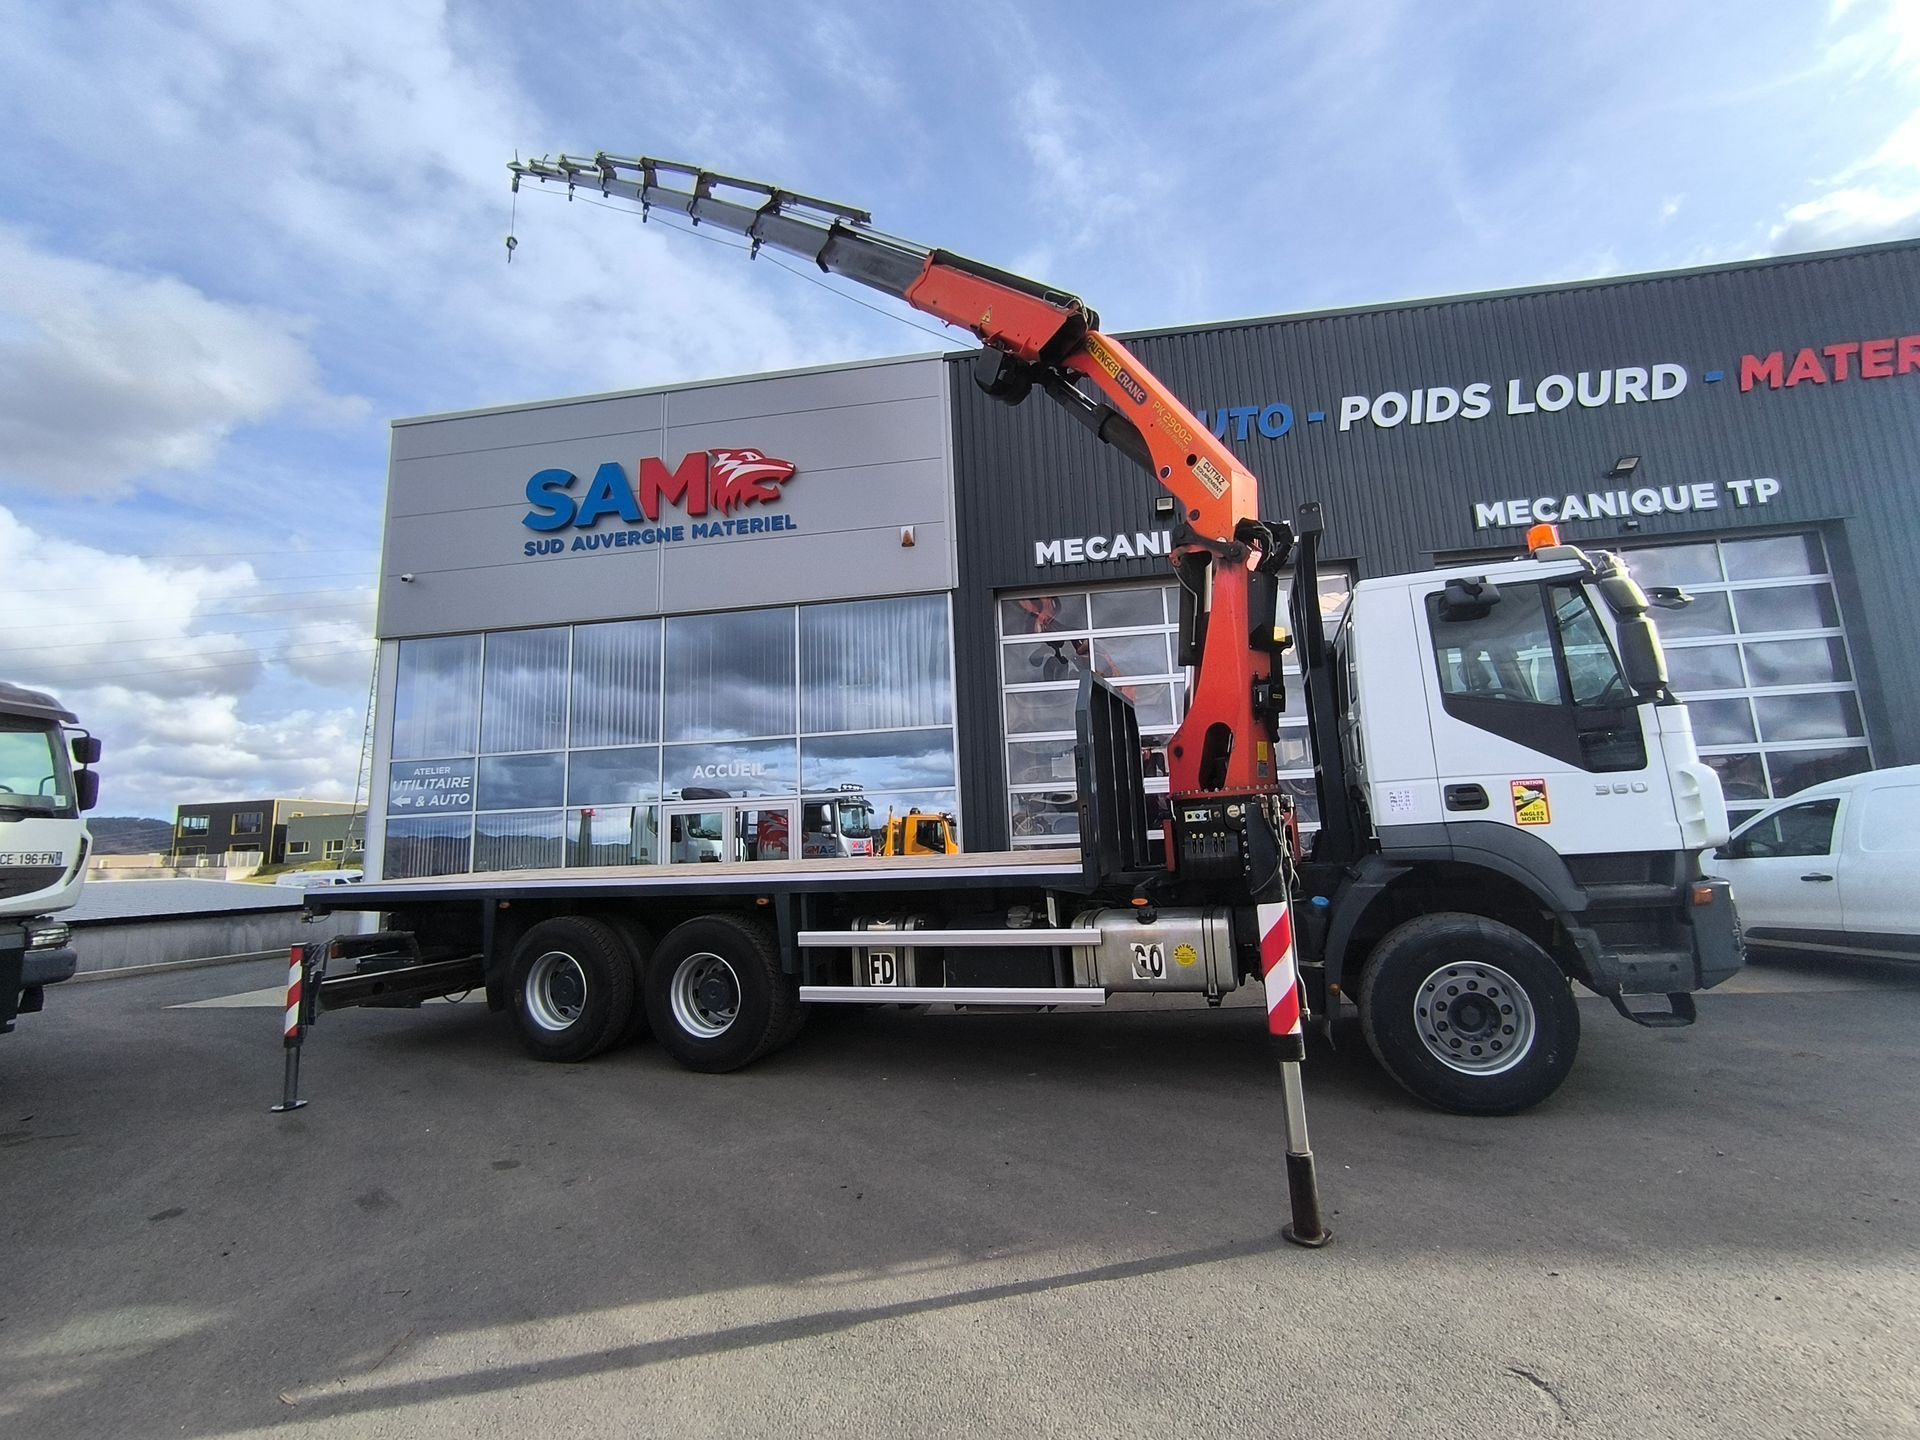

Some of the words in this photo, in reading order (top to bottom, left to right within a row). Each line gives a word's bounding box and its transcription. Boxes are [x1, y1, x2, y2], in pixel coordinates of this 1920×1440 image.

[1117, 371, 1145, 402] CRANE
[1197, 403, 1294, 442] UTO
[1339, 383, 1491, 432] POIDS
[1507, 363, 1688, 415] LOURD
[1152, 401, 1166, 416] PK
[1163, 412, 1193, 445] 29002
[522, 451, 710, 533] SAM
[1475, 482, 1718, 527] MECANIQUE
[1727, 478, 1780, 506] TP
[524, 539, 564, 557] SUD
[571, 525, 684, 552] AUVERGNE
[692, 514, 797, 540] MATERIEL
[1035, 531, 1172, 565] MECANI
[393, 776, 471, 792] UTILITAIRE
[413, 767, 451, 776] ATELIER
[692, 763, 767, 779] ACCUEIL
[415, 796, 425, 807] &
[428, 793, 470, 807] AUTO
[1594, 782, 1648, 795] 360
